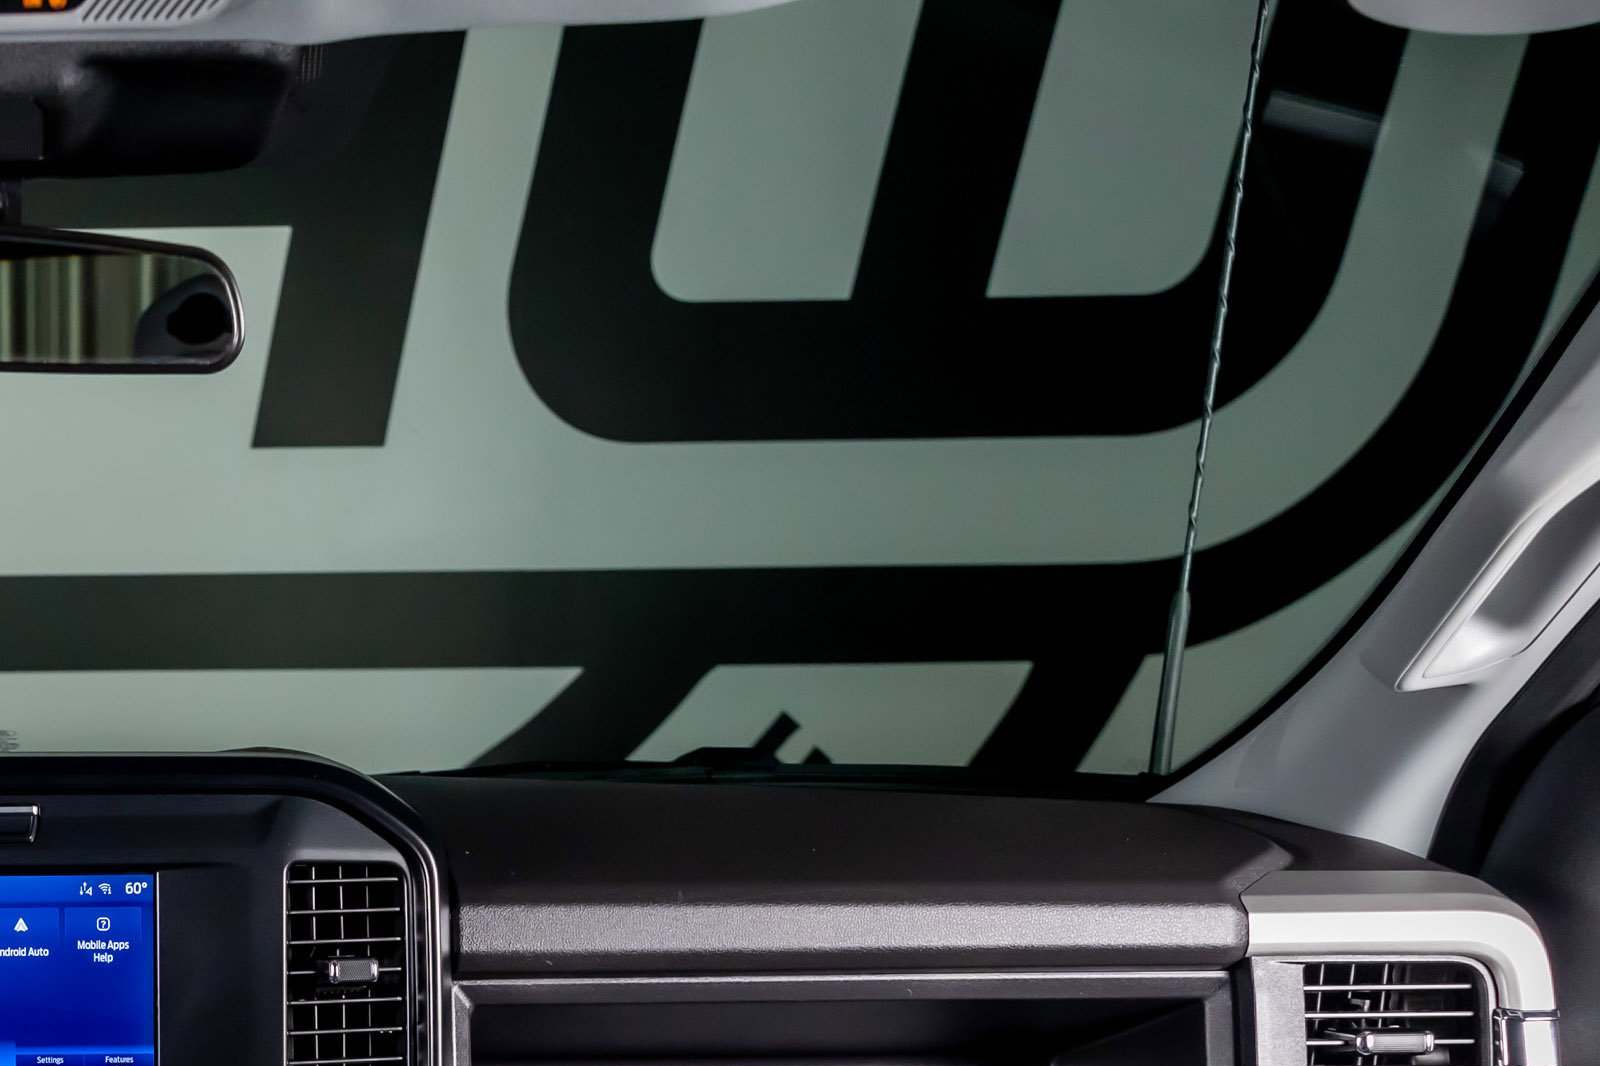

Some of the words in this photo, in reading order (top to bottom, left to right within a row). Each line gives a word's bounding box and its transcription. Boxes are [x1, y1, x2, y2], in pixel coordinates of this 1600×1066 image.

[125, 881, 148, 895] 60°
[77, 940, 106, 950] Mobile
[107, 940, 130, 951] Apps
[28, 947, 50, 957] Auto
[93, 952, 114, 963] Help
[37, 1056, 64, 1064] Settings
